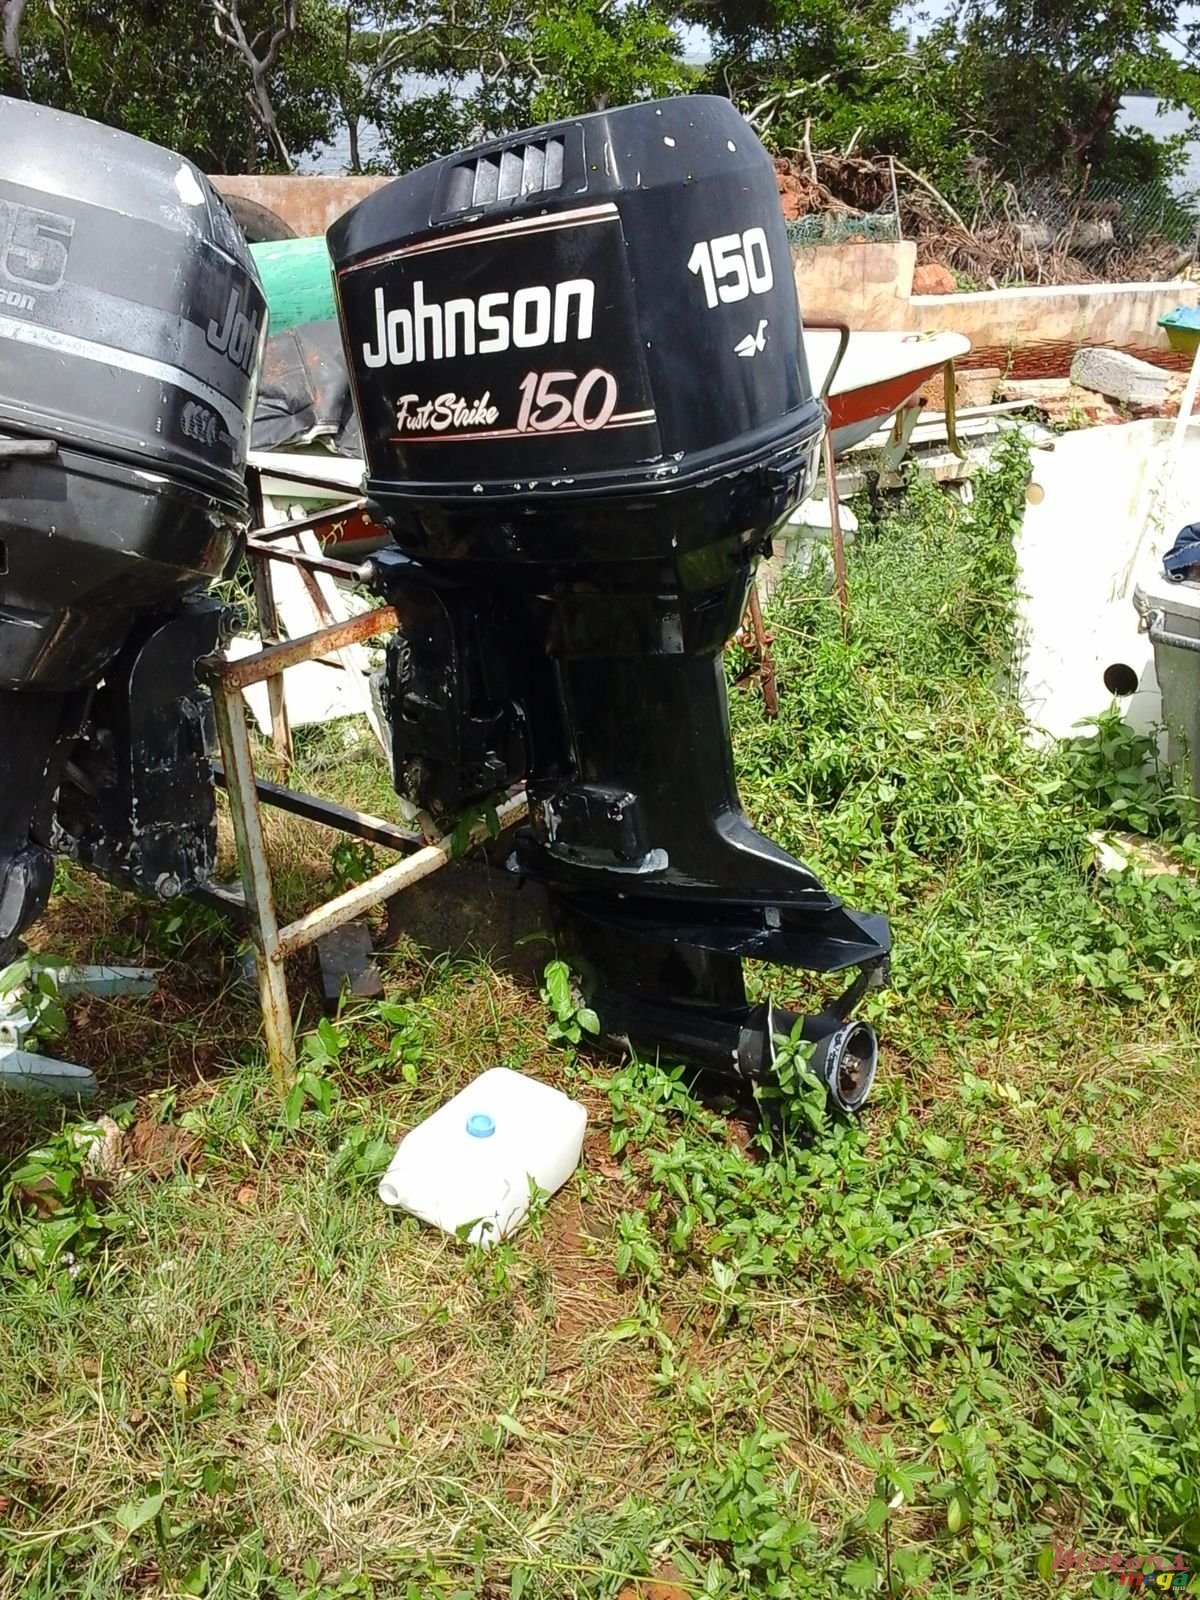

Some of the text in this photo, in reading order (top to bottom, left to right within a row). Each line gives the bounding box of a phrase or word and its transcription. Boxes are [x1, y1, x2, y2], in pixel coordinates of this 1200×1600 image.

[0, 199, 75, 292] 5
[687, 226, 774, 310] 150
[362, 278, 595, 370] Johnson
[518, 367, 619, 433] 150
